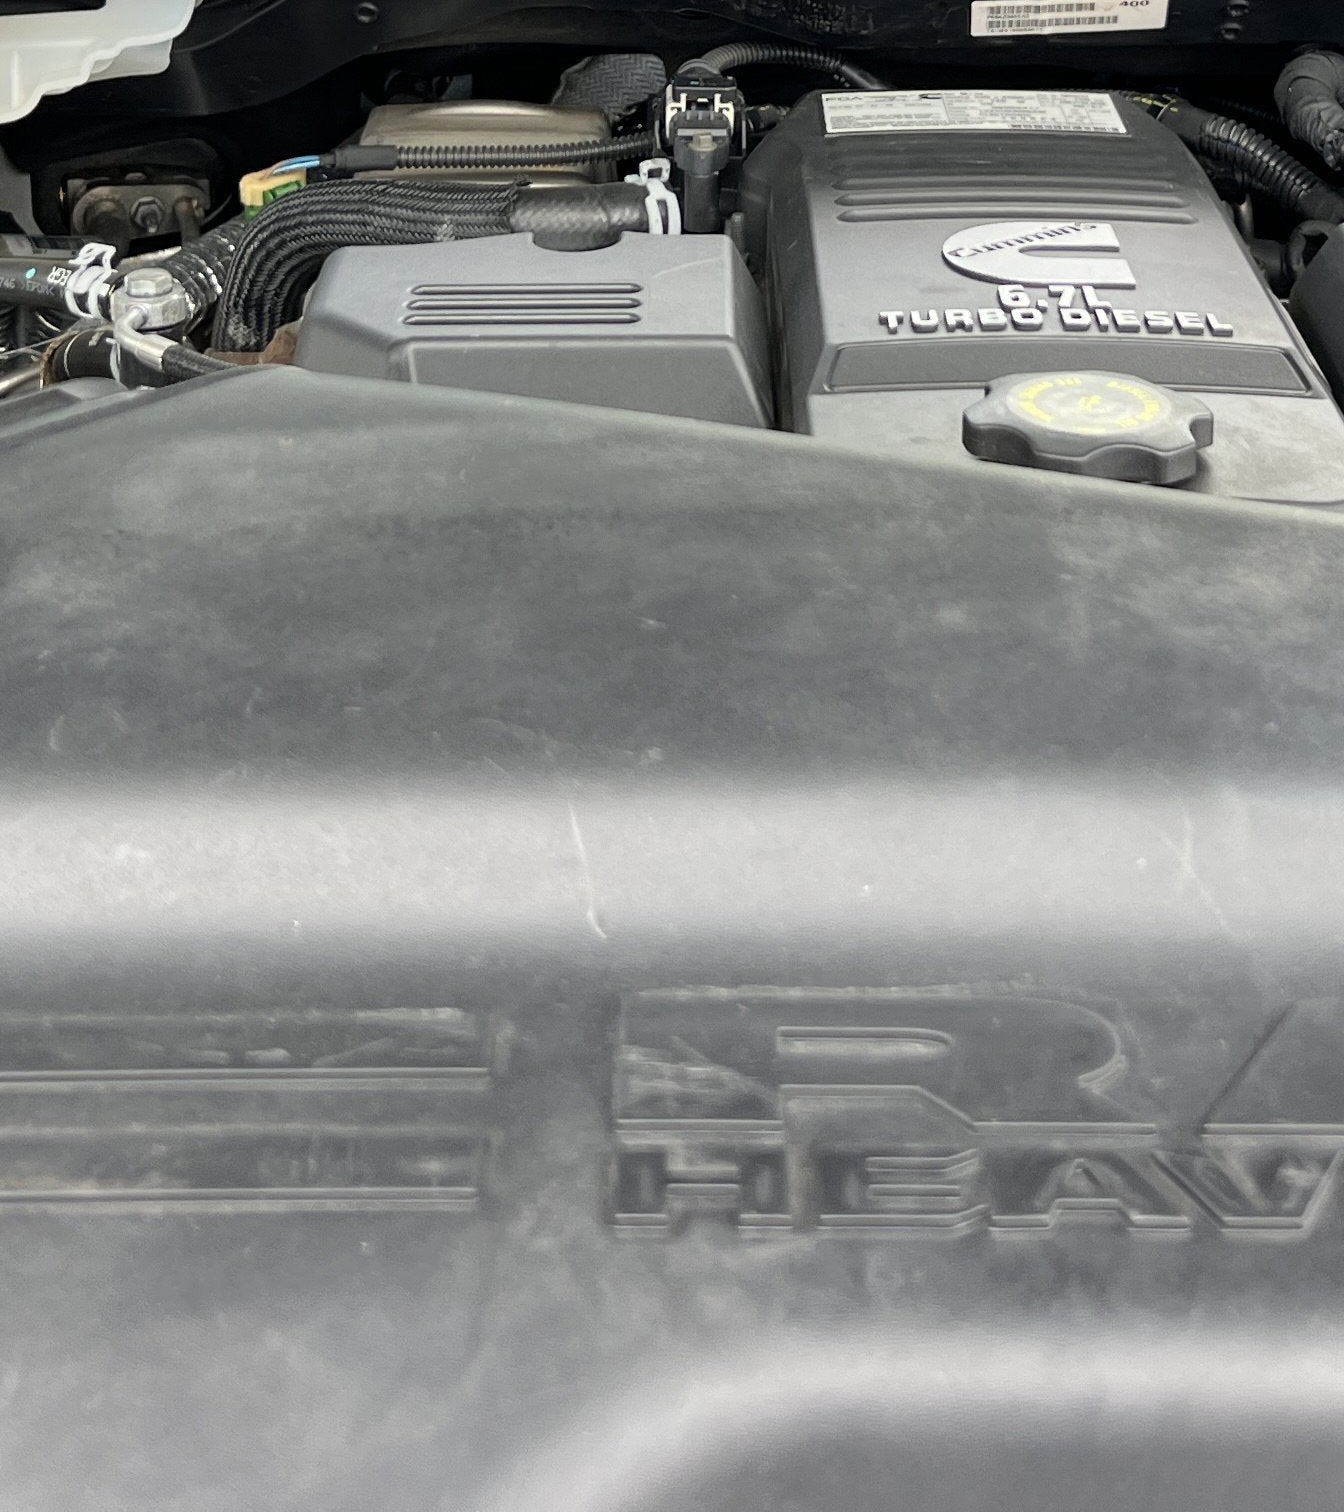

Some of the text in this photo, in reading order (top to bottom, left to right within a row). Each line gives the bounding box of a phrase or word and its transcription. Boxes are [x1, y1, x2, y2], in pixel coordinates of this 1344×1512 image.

[1119, 0, 1150, 8] 400
[996, 284, 1113, 313] 6.7L
[878, 307, 1234, 337] TURBO DIESEL
